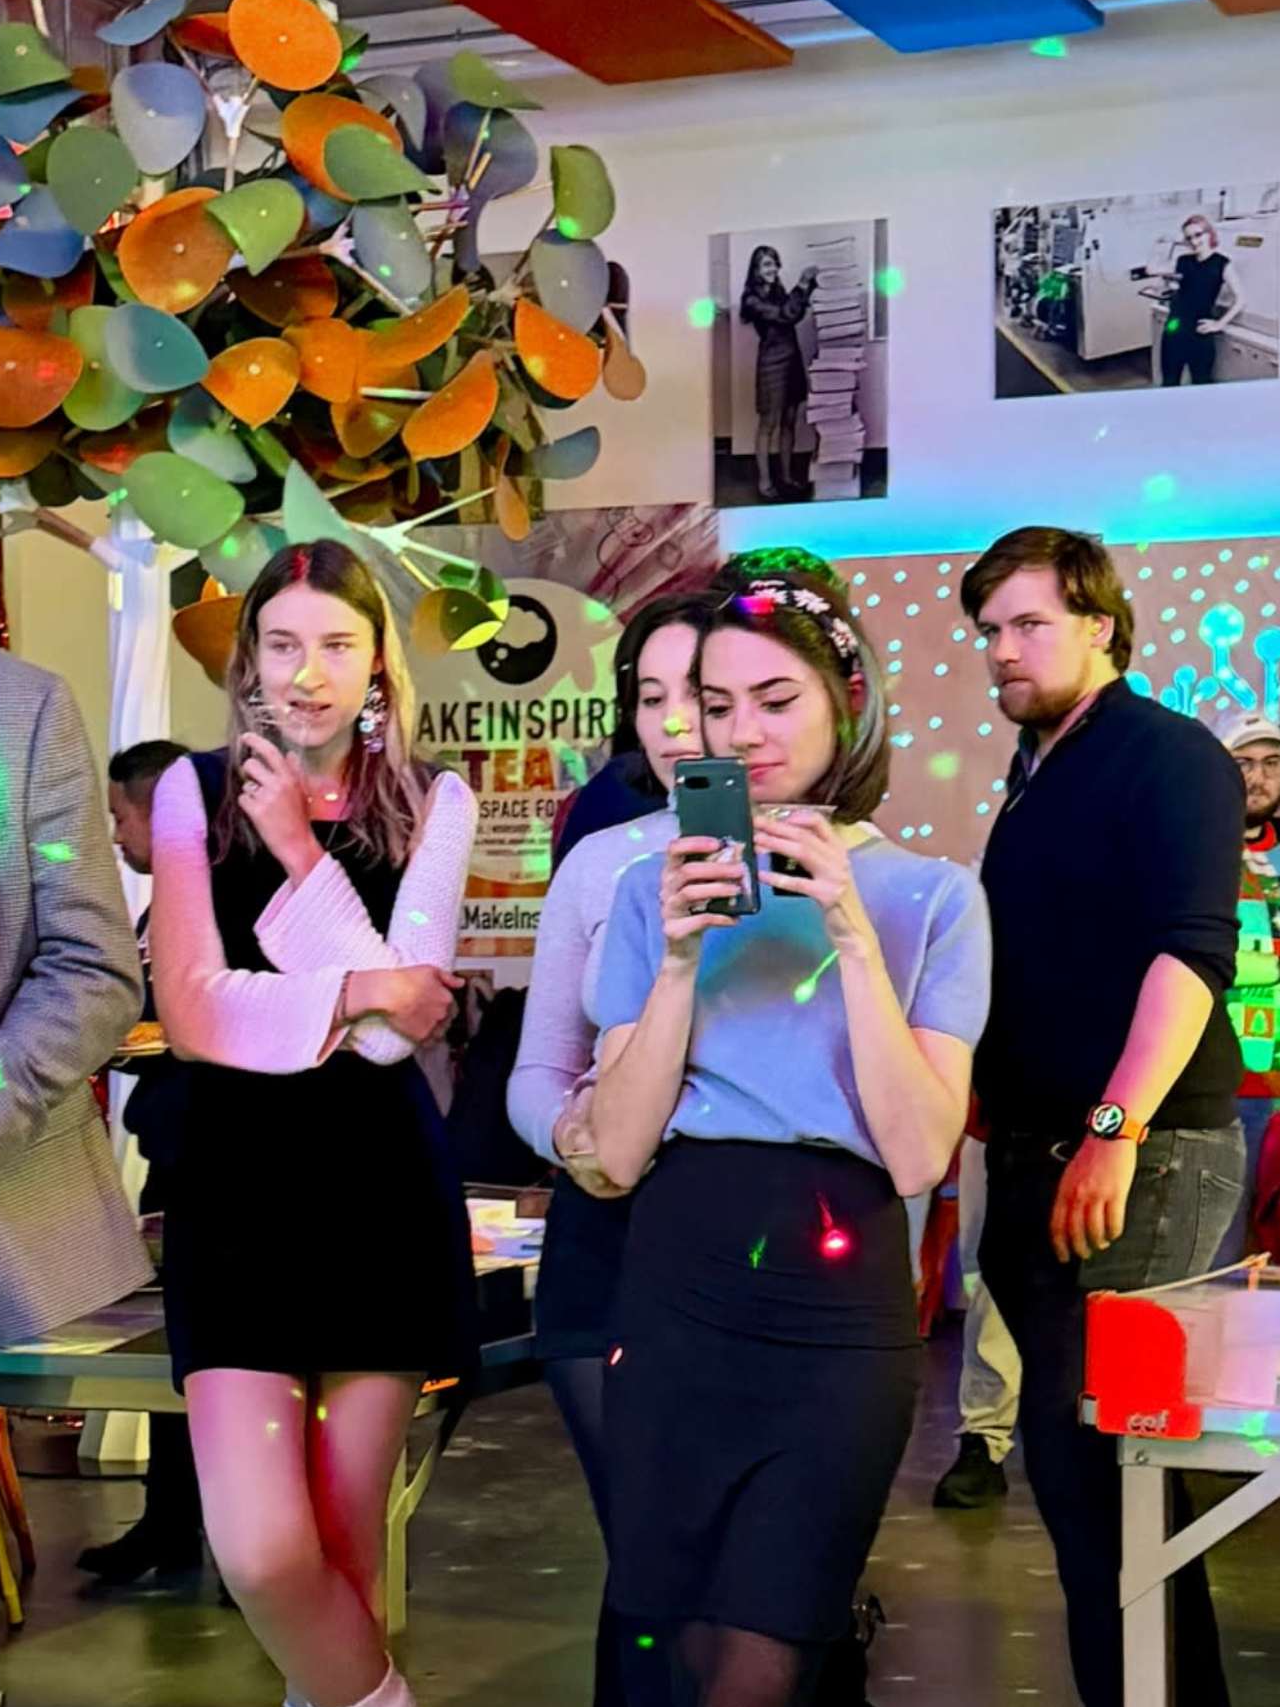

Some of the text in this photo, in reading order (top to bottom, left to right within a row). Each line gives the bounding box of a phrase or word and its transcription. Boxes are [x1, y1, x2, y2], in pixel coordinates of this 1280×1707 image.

[416, 697, 620, 743] AKEINSPIR
[480, 798, 562, 818] SPACE FO
